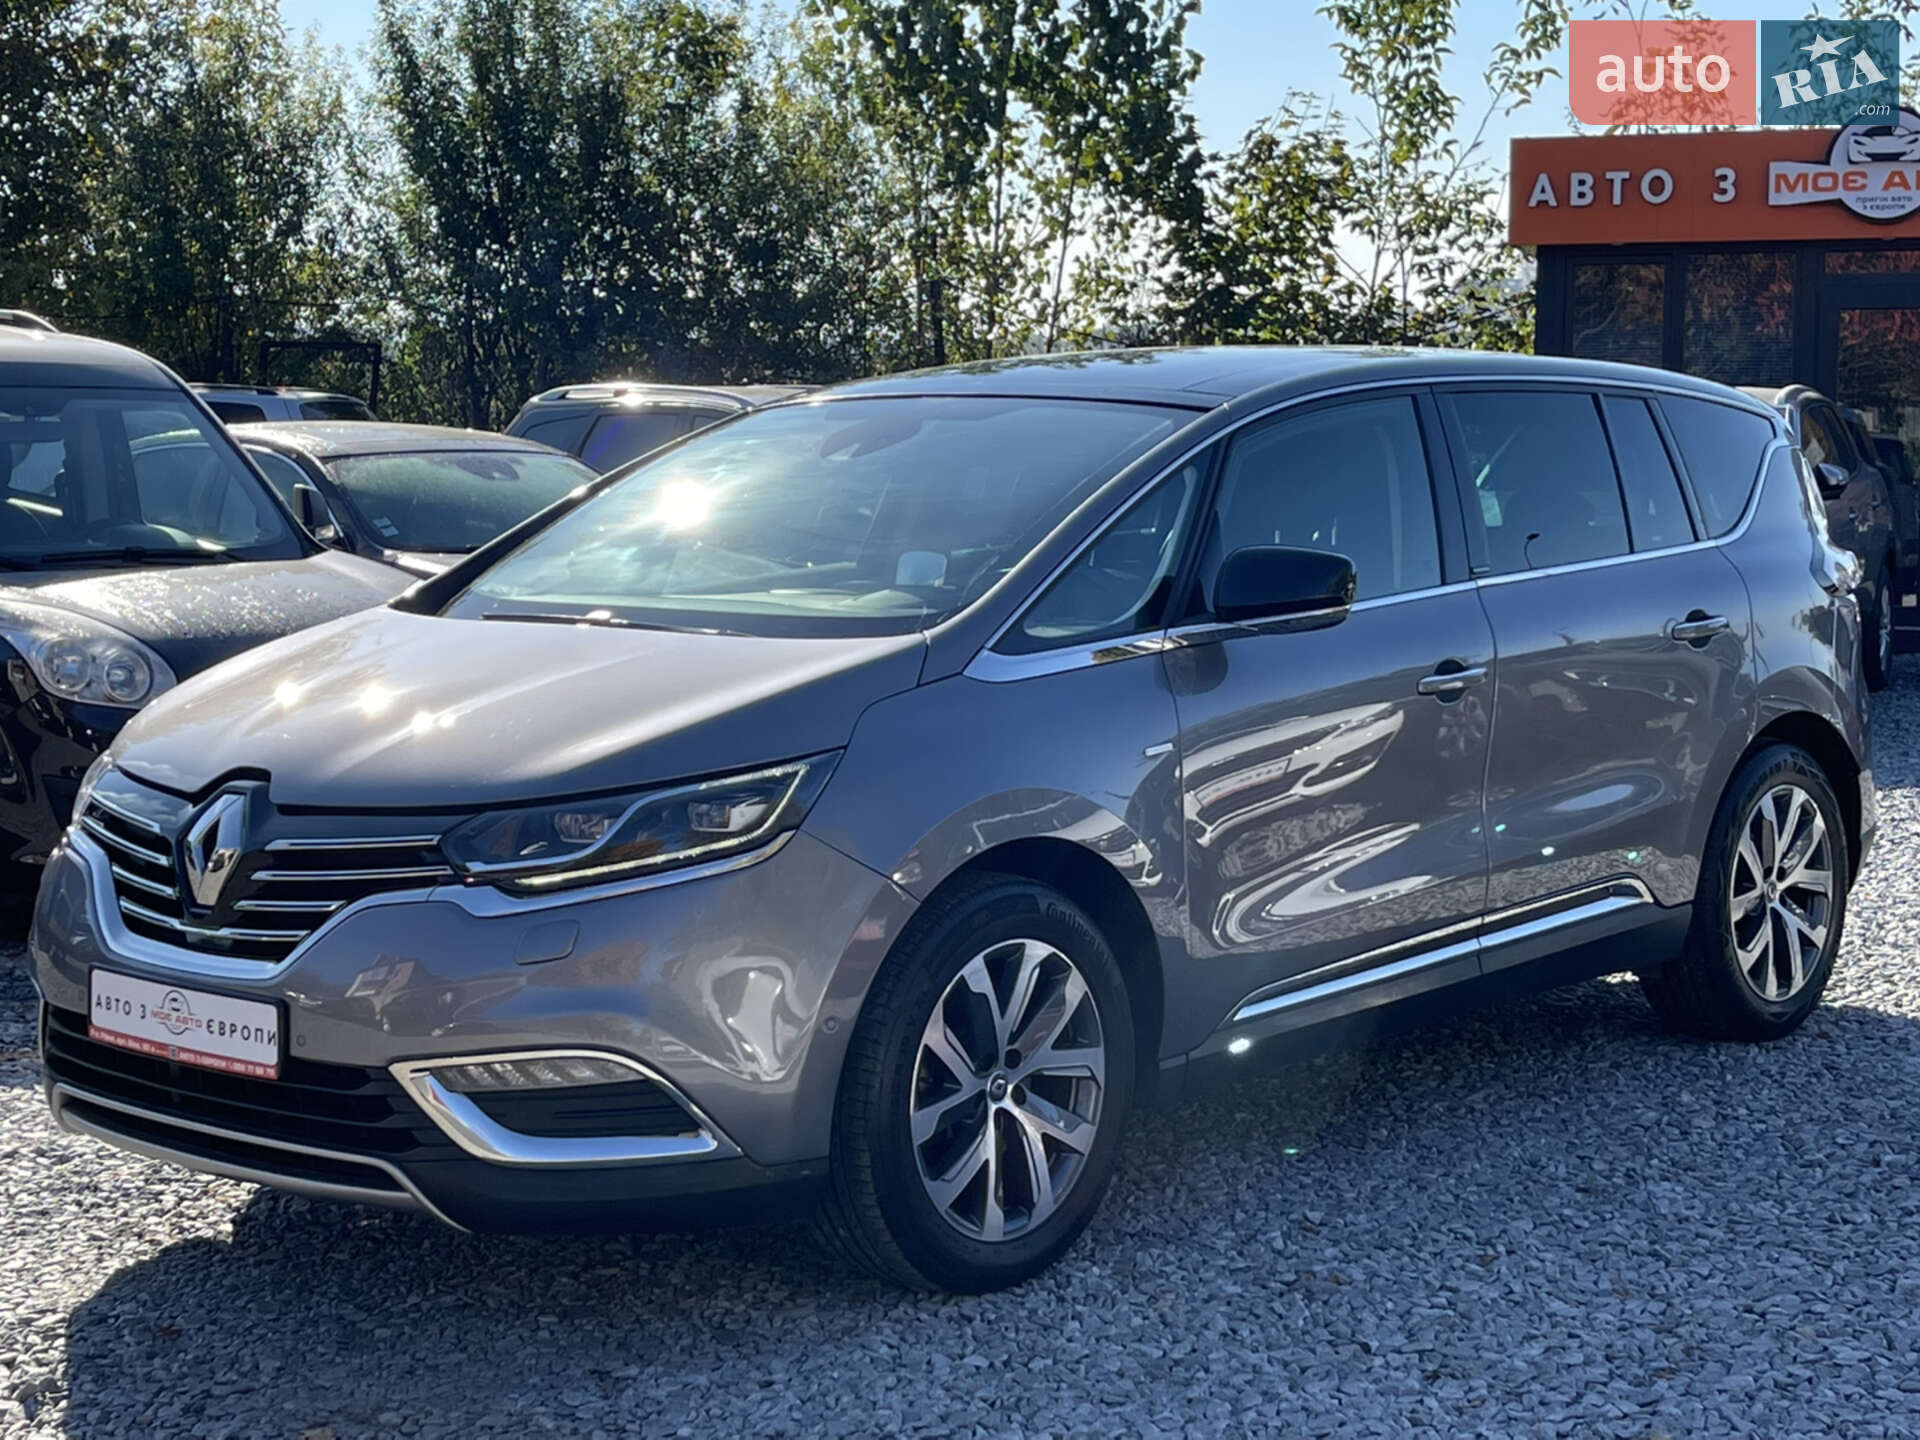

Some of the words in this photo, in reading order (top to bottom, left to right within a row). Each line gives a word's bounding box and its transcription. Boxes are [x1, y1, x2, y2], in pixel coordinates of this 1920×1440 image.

[1528, 168, 1674, 207] АВТО
[1773, 170, 1869, 195] МОЄ
[1881, 169, 1920, 192] А
[95, 993, 132, 1016] АВТО
[206, 1018, 277, 1048] ЄВРОПИ
